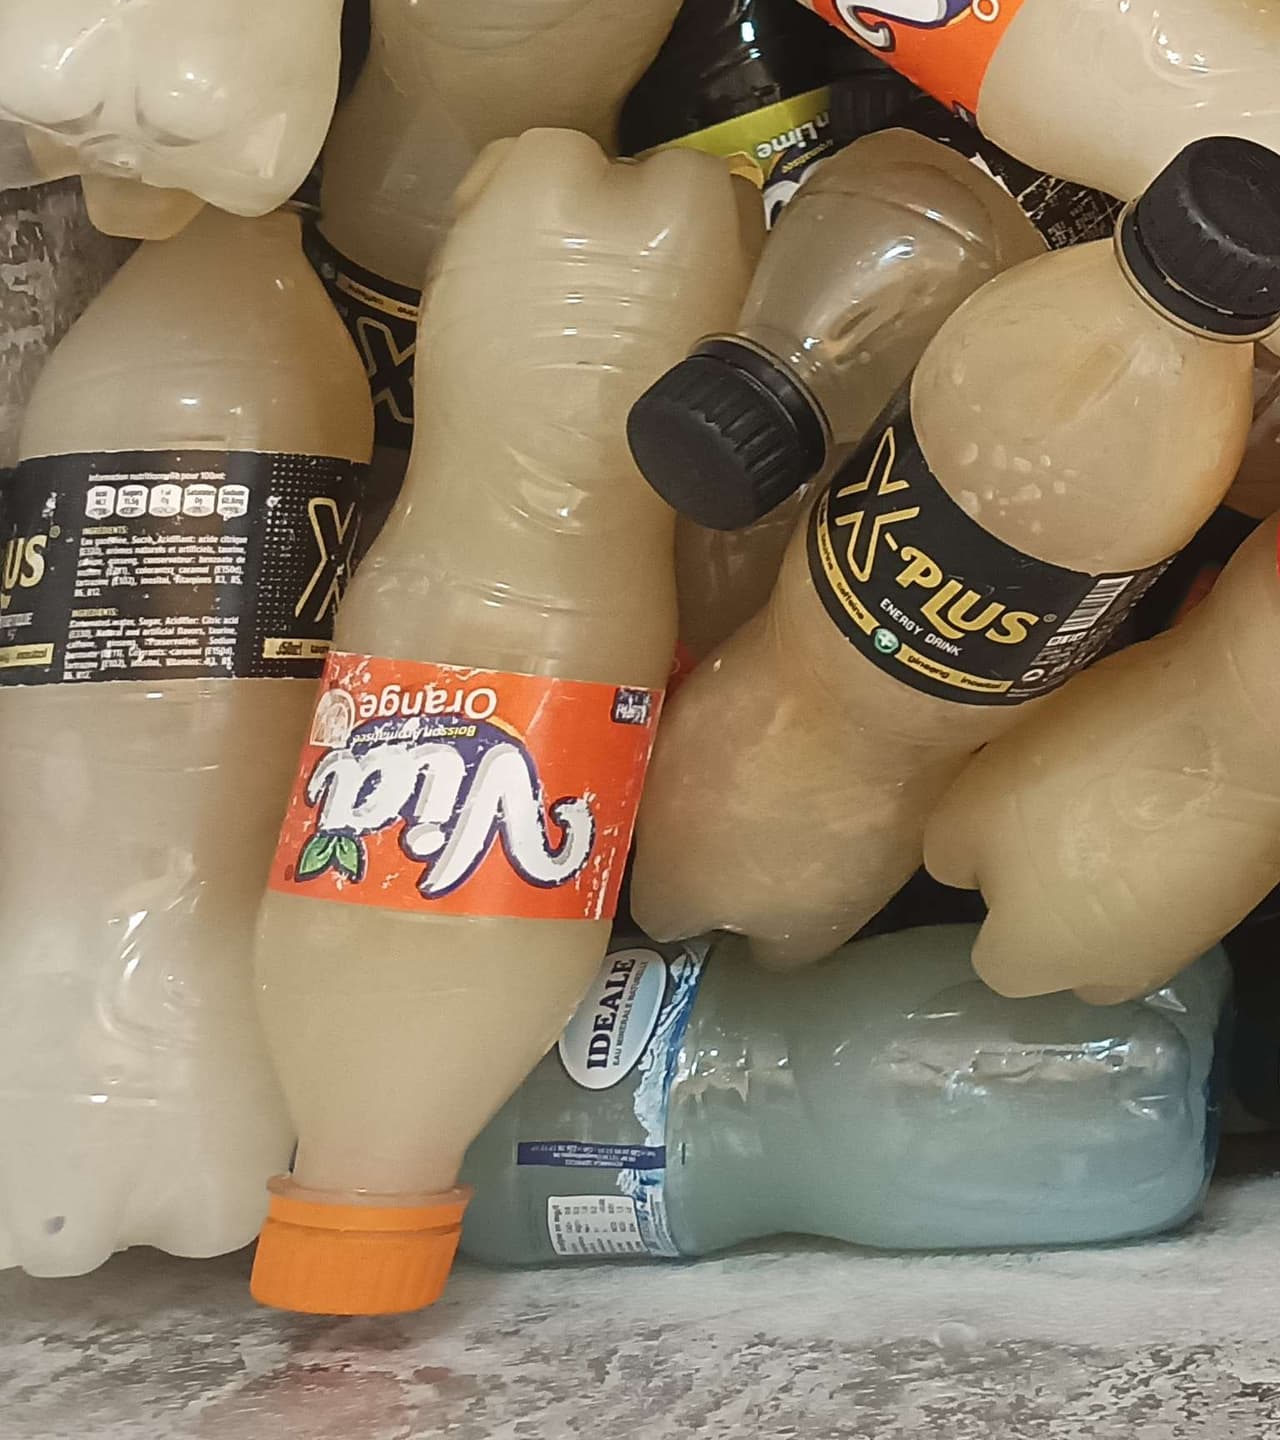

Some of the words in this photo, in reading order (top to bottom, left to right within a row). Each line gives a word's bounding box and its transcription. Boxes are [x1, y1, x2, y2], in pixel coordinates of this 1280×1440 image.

[833, 426, 1041, 648] X-PLUS
[874, 597, 928, 637] ENERGY
[923, 630, 963, 657] DRINK
[358, 682, 498, 724] Orange
[308, 744, 595, 898] Via
[585, 953, 635, 1073] IDEALE
